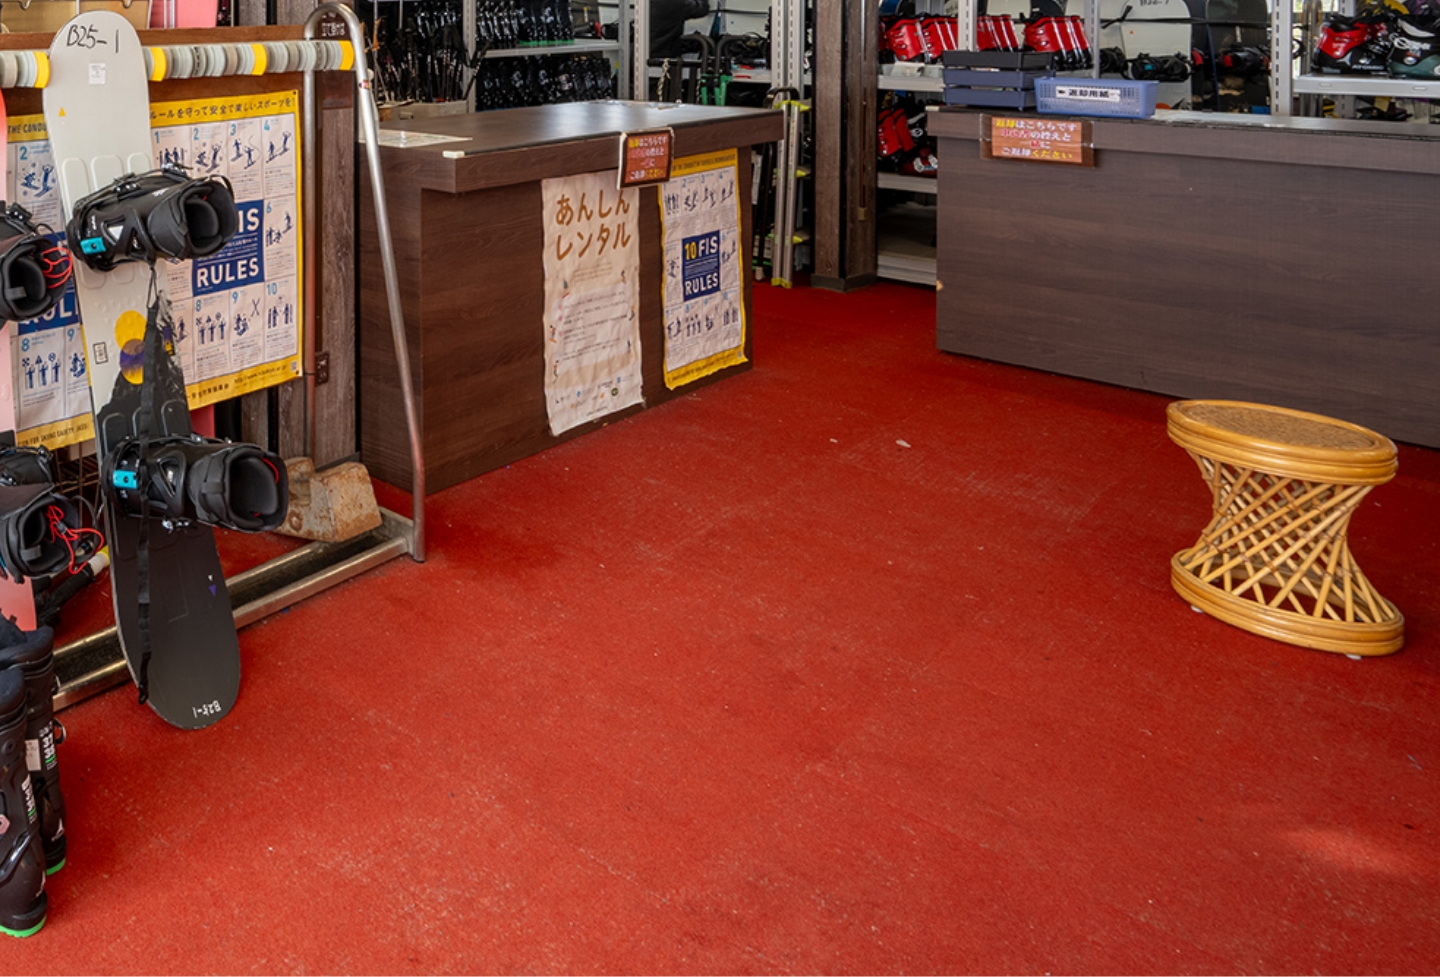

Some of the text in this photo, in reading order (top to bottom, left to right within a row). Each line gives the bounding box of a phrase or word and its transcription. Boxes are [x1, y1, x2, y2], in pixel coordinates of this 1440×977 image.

[23, 122, 47, 133] CONDU
[193, 127, 199, 141] 2
[230, 124, 237, 136] 3
[154, 131, 160, 144] 1
[19, 146, 28, 160] 2
[266, 202, 272, 214] 6
[556, 189, 630, 225] あんしん
[238, 208, 260, 233] IS
[557, 222, 631, 261] レンタル
[685, 236, 718, 260] 10 FIS
[197, 257, 259, 288] RULES
[267, 283, 278, 295] 10
[685, 272, 718, 295] RULES
[232, 291, 239, 304] 9
[195, 299, 202, 312] 8
[67, 328, 75, 342] 9
[21, 338, 30, 352] 8
